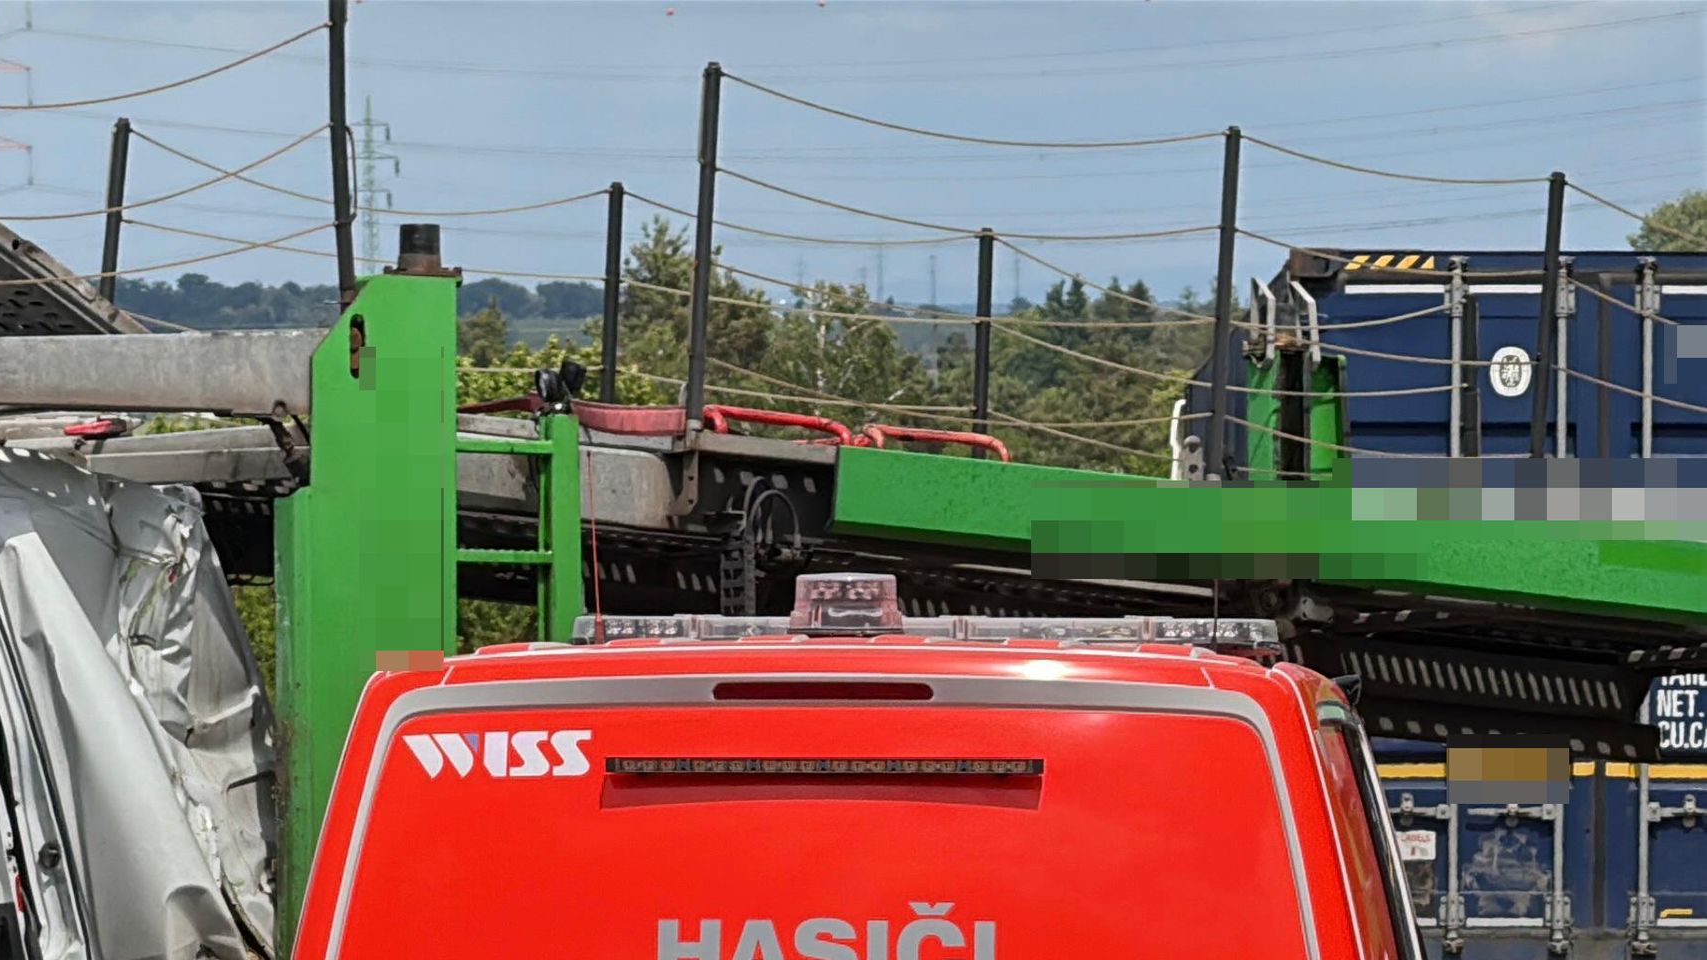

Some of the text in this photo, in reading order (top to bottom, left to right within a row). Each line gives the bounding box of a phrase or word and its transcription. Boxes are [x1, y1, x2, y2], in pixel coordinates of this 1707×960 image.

[1657, 689, 1705, 717] NET.
[1658, 721, 1707, 749] CU.C
[402, 730, 592, 779] WISS
